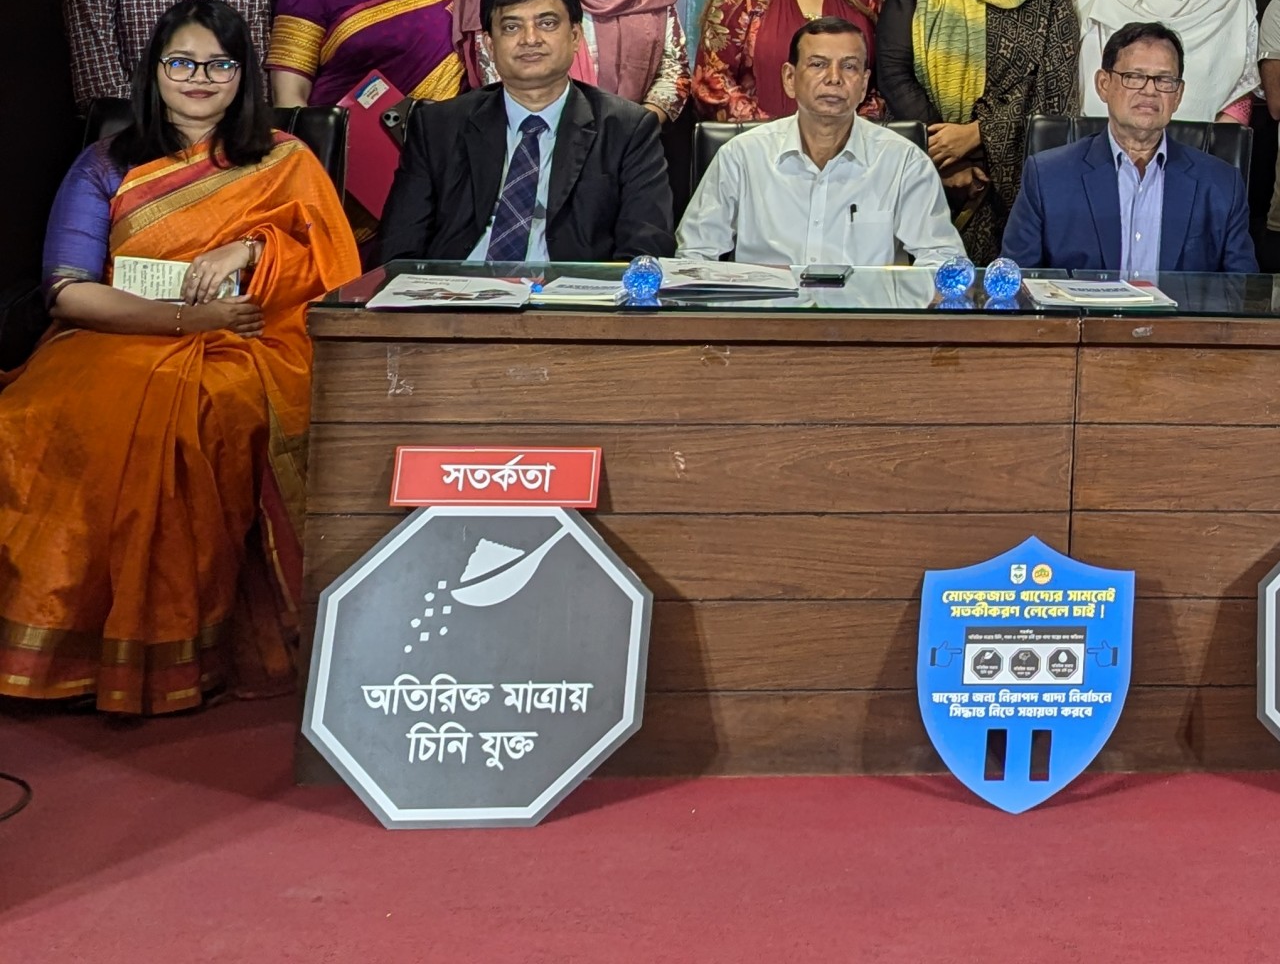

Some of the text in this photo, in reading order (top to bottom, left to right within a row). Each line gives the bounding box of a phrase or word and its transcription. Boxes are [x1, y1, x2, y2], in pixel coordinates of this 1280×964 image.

[440, 454, 556, 493] সতর্কতা
[1067, 587, 1116, 603] সামনেই
[1024, 605, 1069, 619] লেবেল
[1073, 603, 1095, 618] চাই
[361, 673, 593, 716] অতিরিক্ত মাত্রায়
[972, 692, 996, 703] জন্য
[998, 689, 1039, 703] নিরাপদ
[1069, 688, 1112, 703] নির্বাচনে
[988, 703, 1015, 718] নিতে
[1017, 706, 1058, 718] সহায়তা
[1061, 706, 1093, 718] করবে
[406, 721, 539, 771] চিনি যুক্ত
